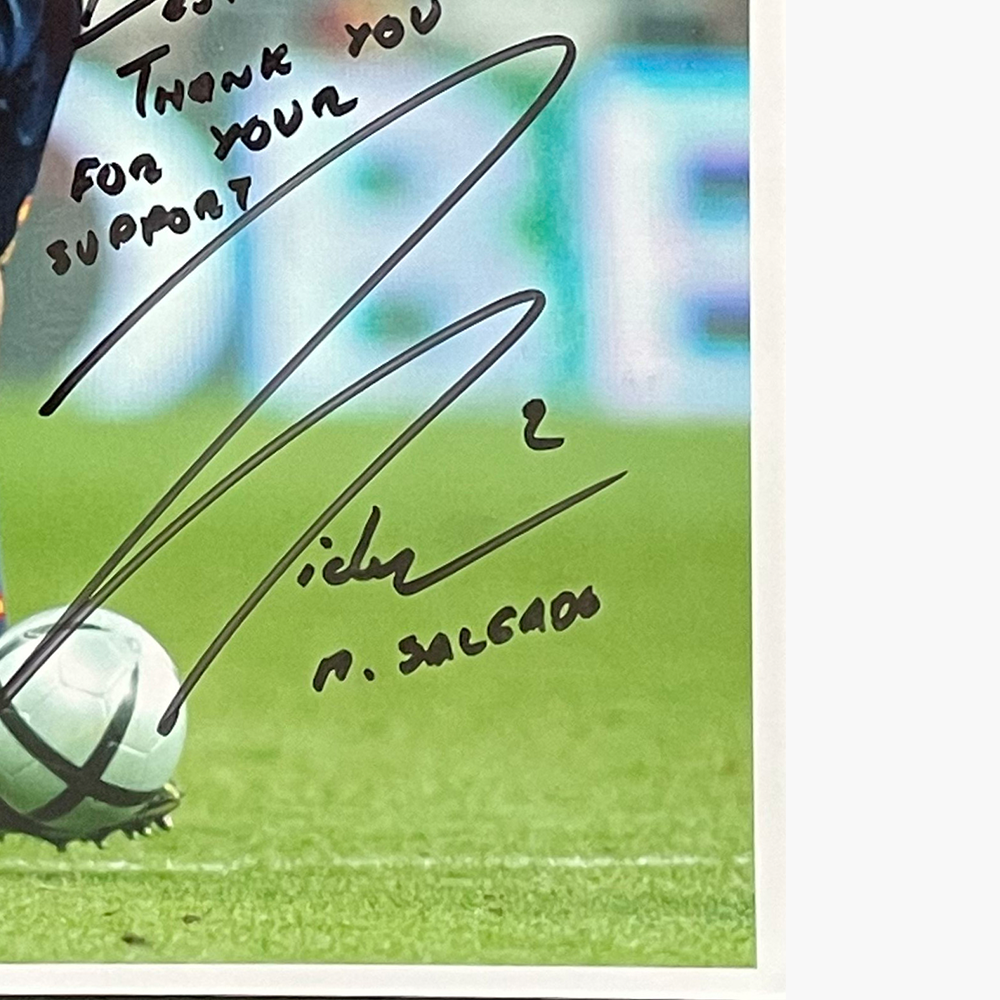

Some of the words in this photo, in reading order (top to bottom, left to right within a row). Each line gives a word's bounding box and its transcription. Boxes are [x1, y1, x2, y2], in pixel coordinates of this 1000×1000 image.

[69, 152, 164, 204] FOR
[209, 85, 360, 162] YOUR
[45, 175, 253, 276] SUPPORT
[522, 398, 566, 452] 2
[397, 585, 602, 676] SALGADO
